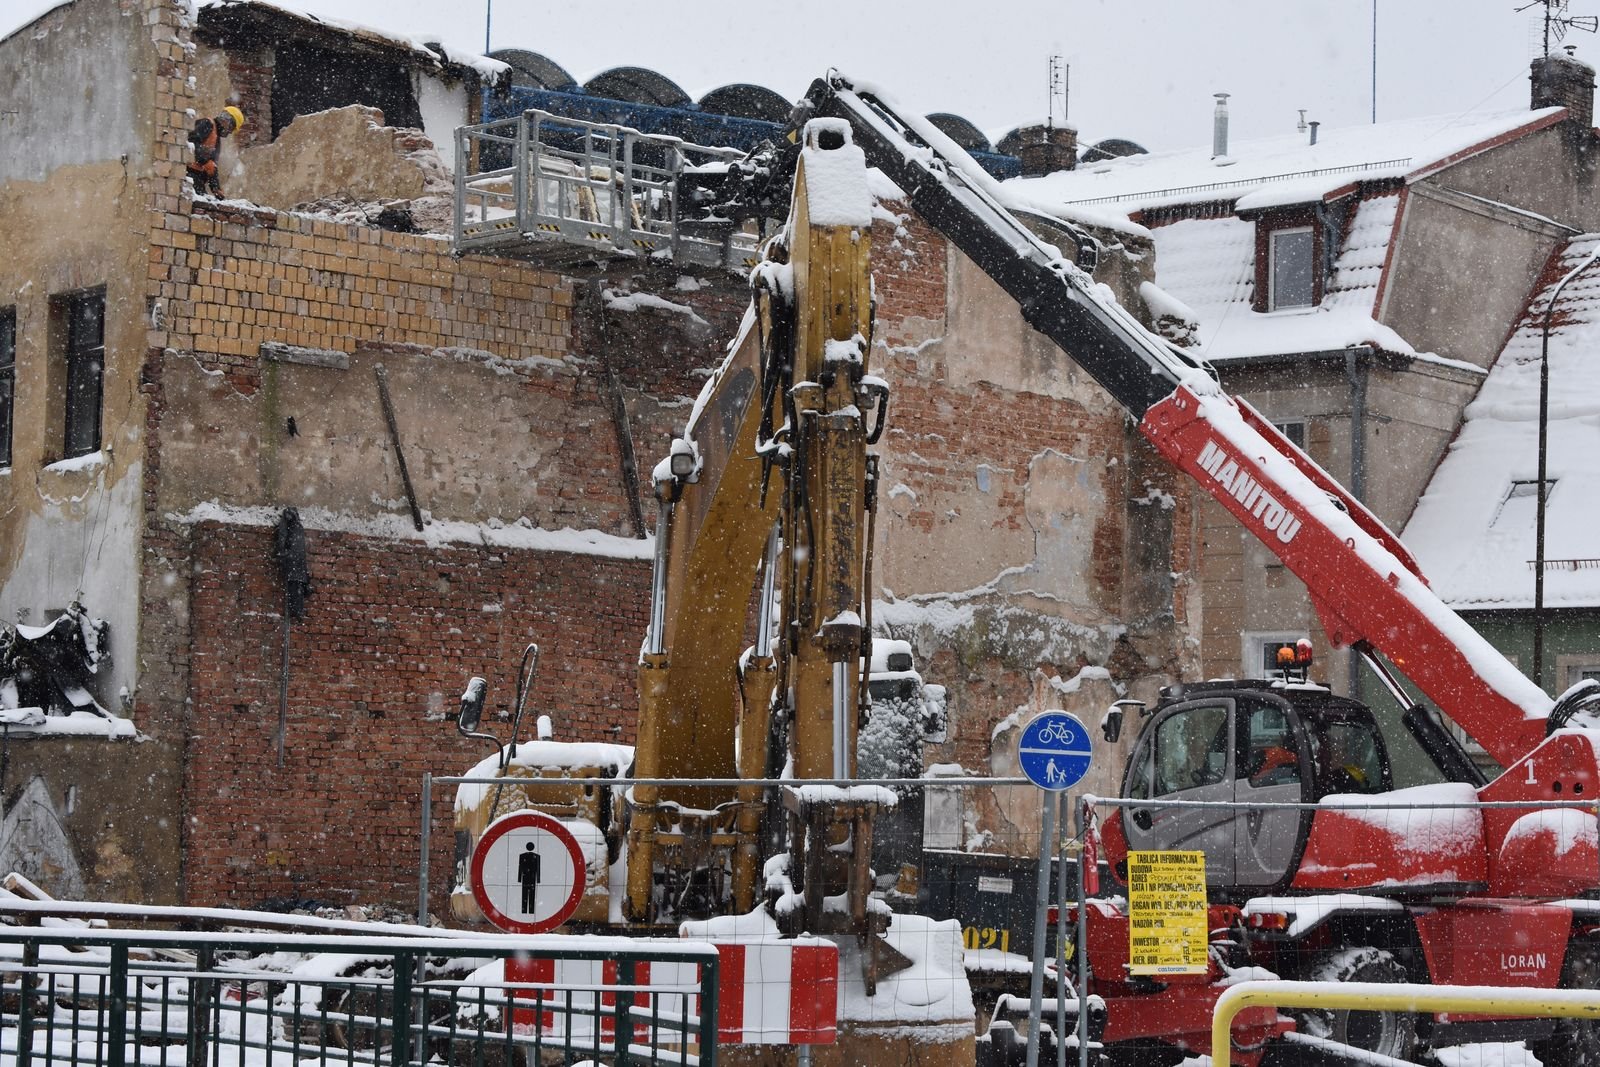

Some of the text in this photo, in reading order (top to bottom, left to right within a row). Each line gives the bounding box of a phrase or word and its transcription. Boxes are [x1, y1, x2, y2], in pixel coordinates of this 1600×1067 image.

[1196, 438, 1302, 543] MANITOU
[1524, 758, 1538, 785] 1
[1136, 854, 1198, 864] TABLICA INFORMACYJNA
[1131, 865, 1153, 874] BUDOWA
[1131, 874, 1148, 883] ADRES
[1132, 883, 1145, 892] DATA
[1148, 883, 1157, 892] NR
[1132, 918, 1153, 928] NADZÓR
[1133, 937, 1160, 947] INWESTOR
[1501, 953, 1546, 969] LORAN
